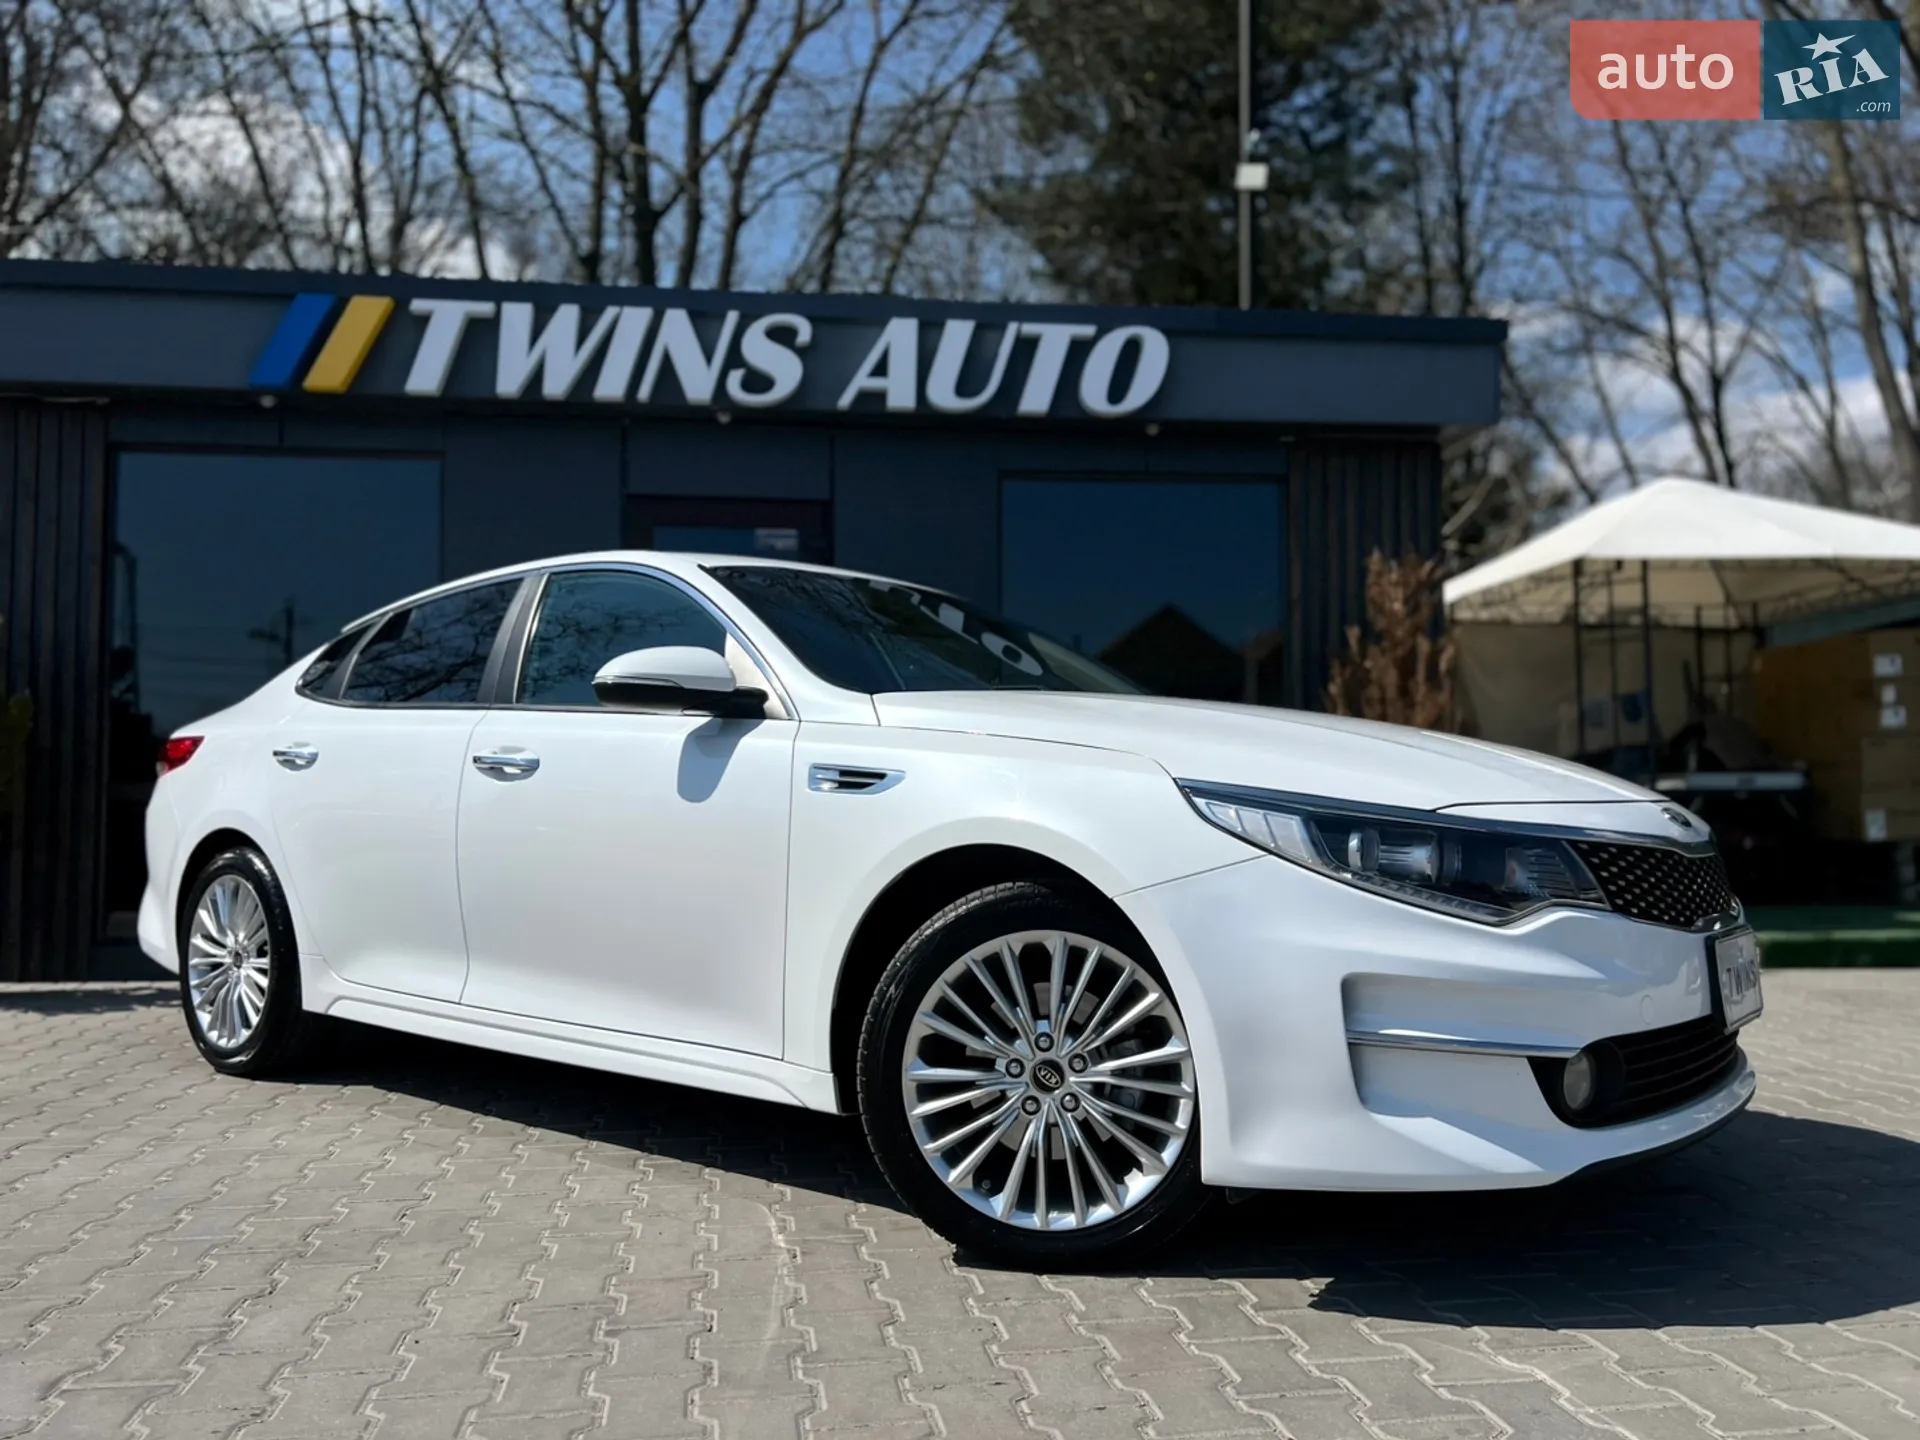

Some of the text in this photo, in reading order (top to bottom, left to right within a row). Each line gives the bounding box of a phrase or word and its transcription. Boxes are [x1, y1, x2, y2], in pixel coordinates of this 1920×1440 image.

[404, 298, 1170, 418] TWINS AUTO
[1040, 1067, 1059, 1085] KIA
